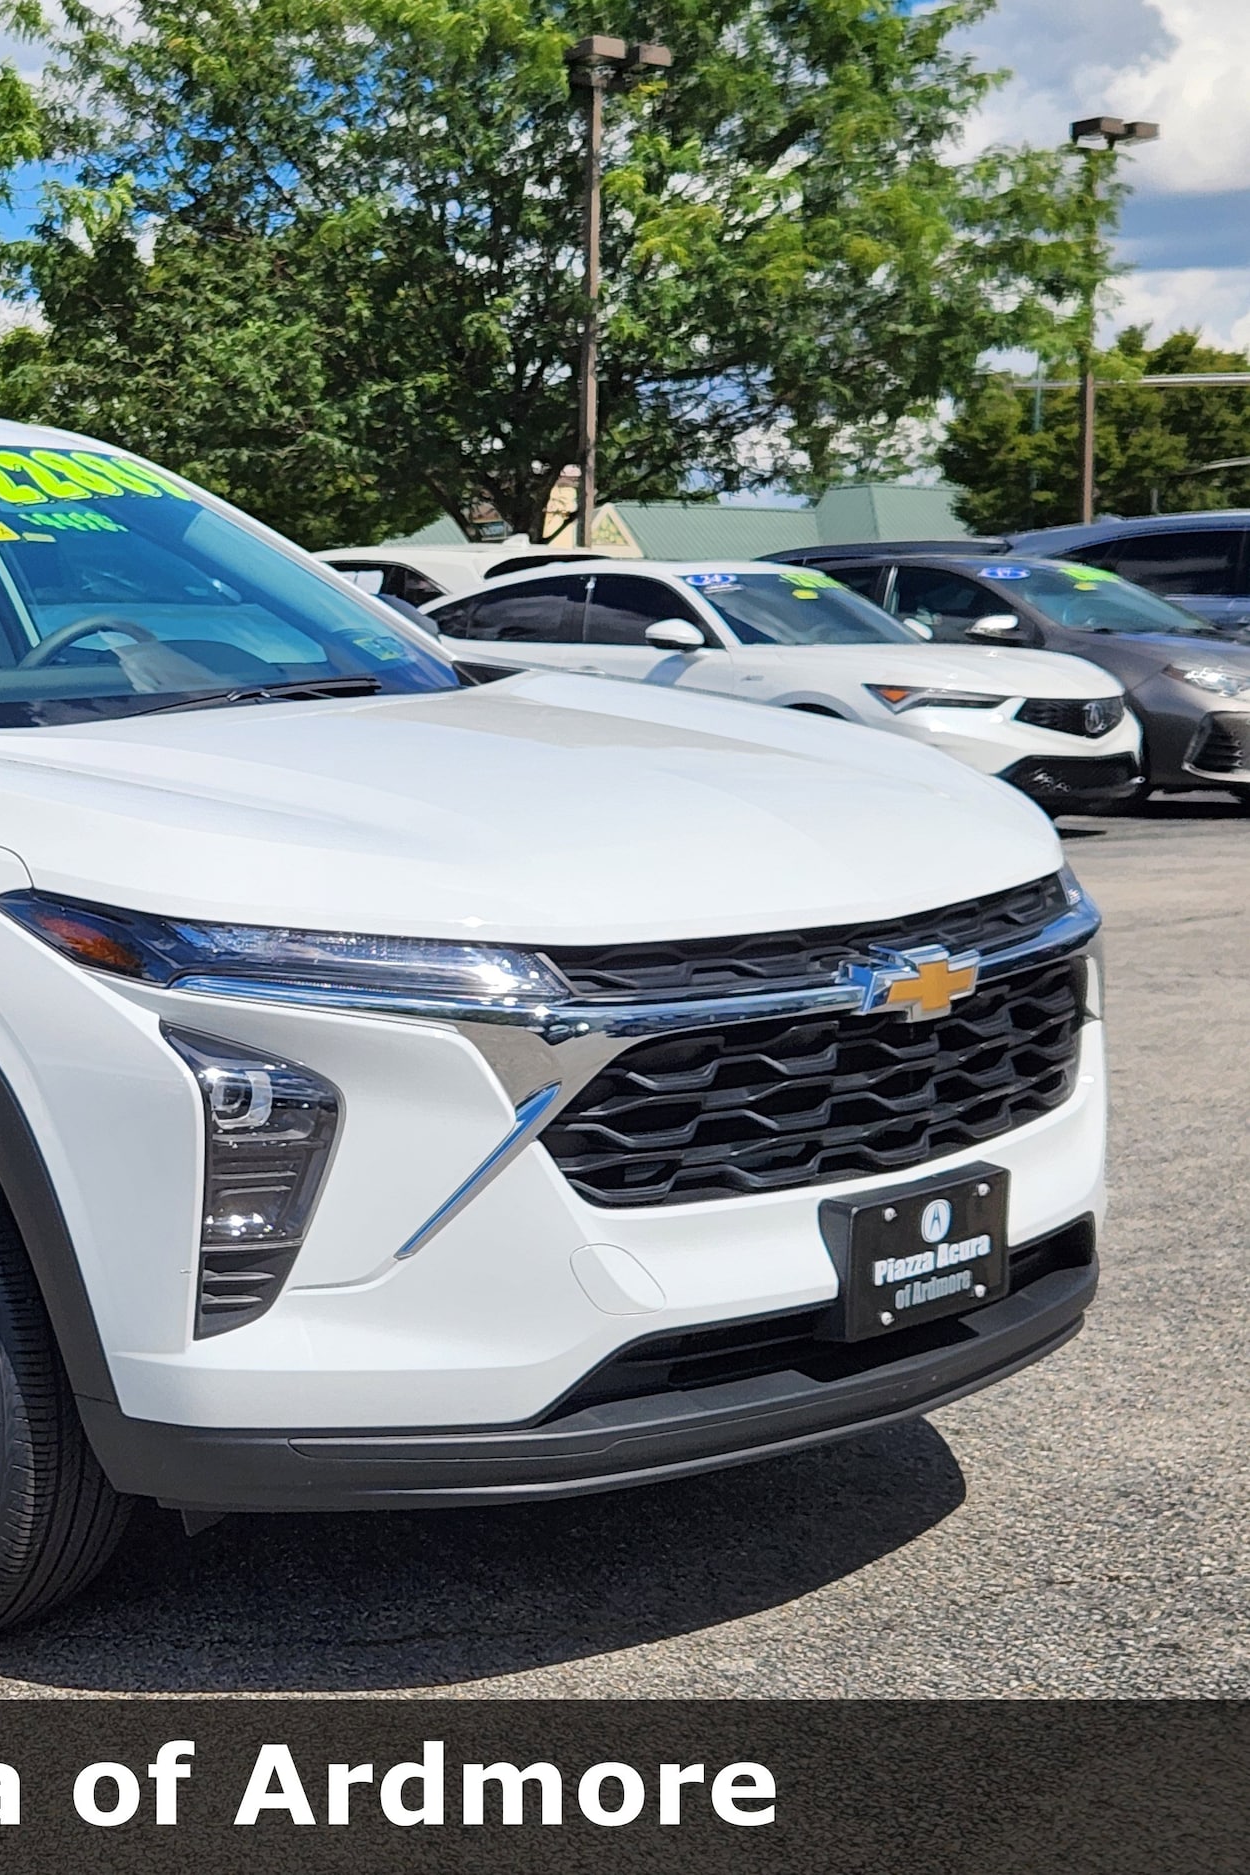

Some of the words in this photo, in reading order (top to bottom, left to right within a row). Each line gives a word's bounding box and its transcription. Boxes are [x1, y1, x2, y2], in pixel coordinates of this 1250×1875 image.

[873, 1250, 935, 1287] Piazza
[936, 1234, 991, 1269] Acura
[894, 1283, 913, 1310] of
[911, 1269, 973, 1306] Ardmore
